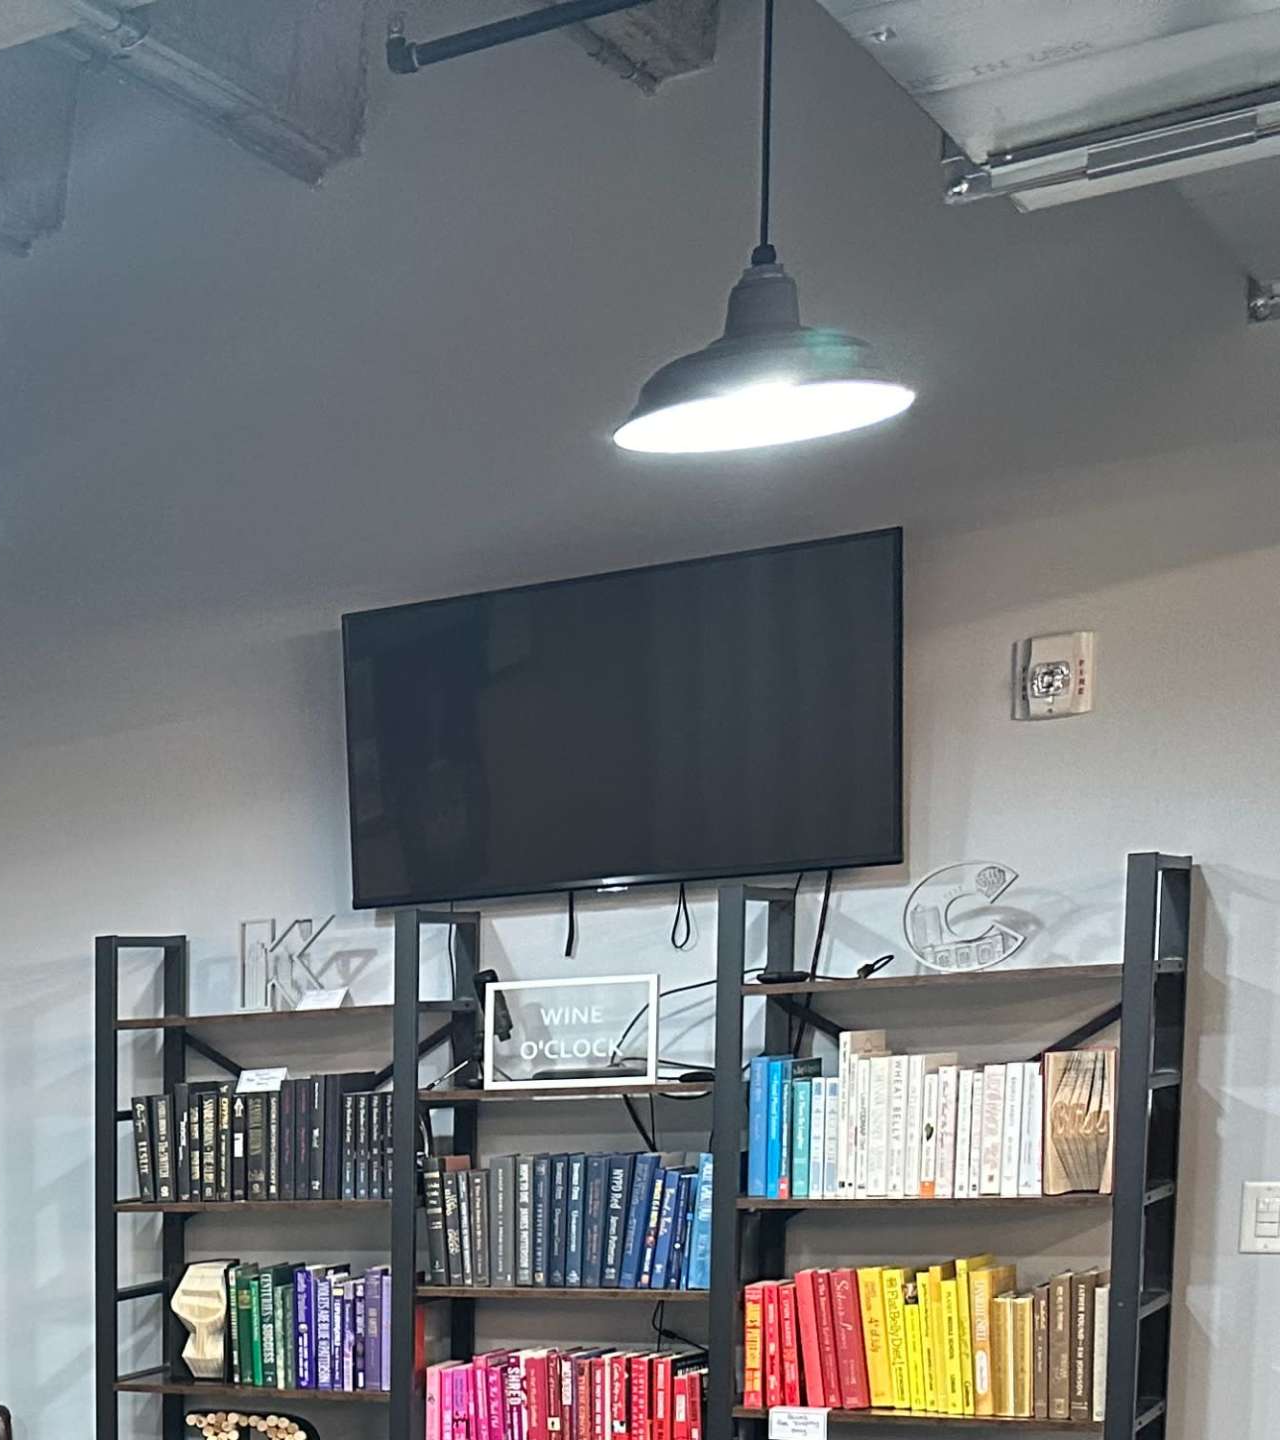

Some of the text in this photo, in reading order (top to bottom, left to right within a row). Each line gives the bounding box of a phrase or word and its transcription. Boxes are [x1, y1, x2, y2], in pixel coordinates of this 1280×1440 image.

[540, 1006, 604, 1026] WINE
[520, 1038, 623, 1060] O'CLOCK
[892, 1060, 902, 1142] WHEAT BELLY
[612, 1168, 624, 1191] NYPD
[609, 1192, 622, 1210] Red
[887, 1290, 899, 1310] Flat
[1077, 1284, 1085, 1312] FATHER
[887, 1310, 899, 1337] Belly
[262, 1323, 274, 1363] SUCCESS
[507, 1367, 521, 1406] SHRED
